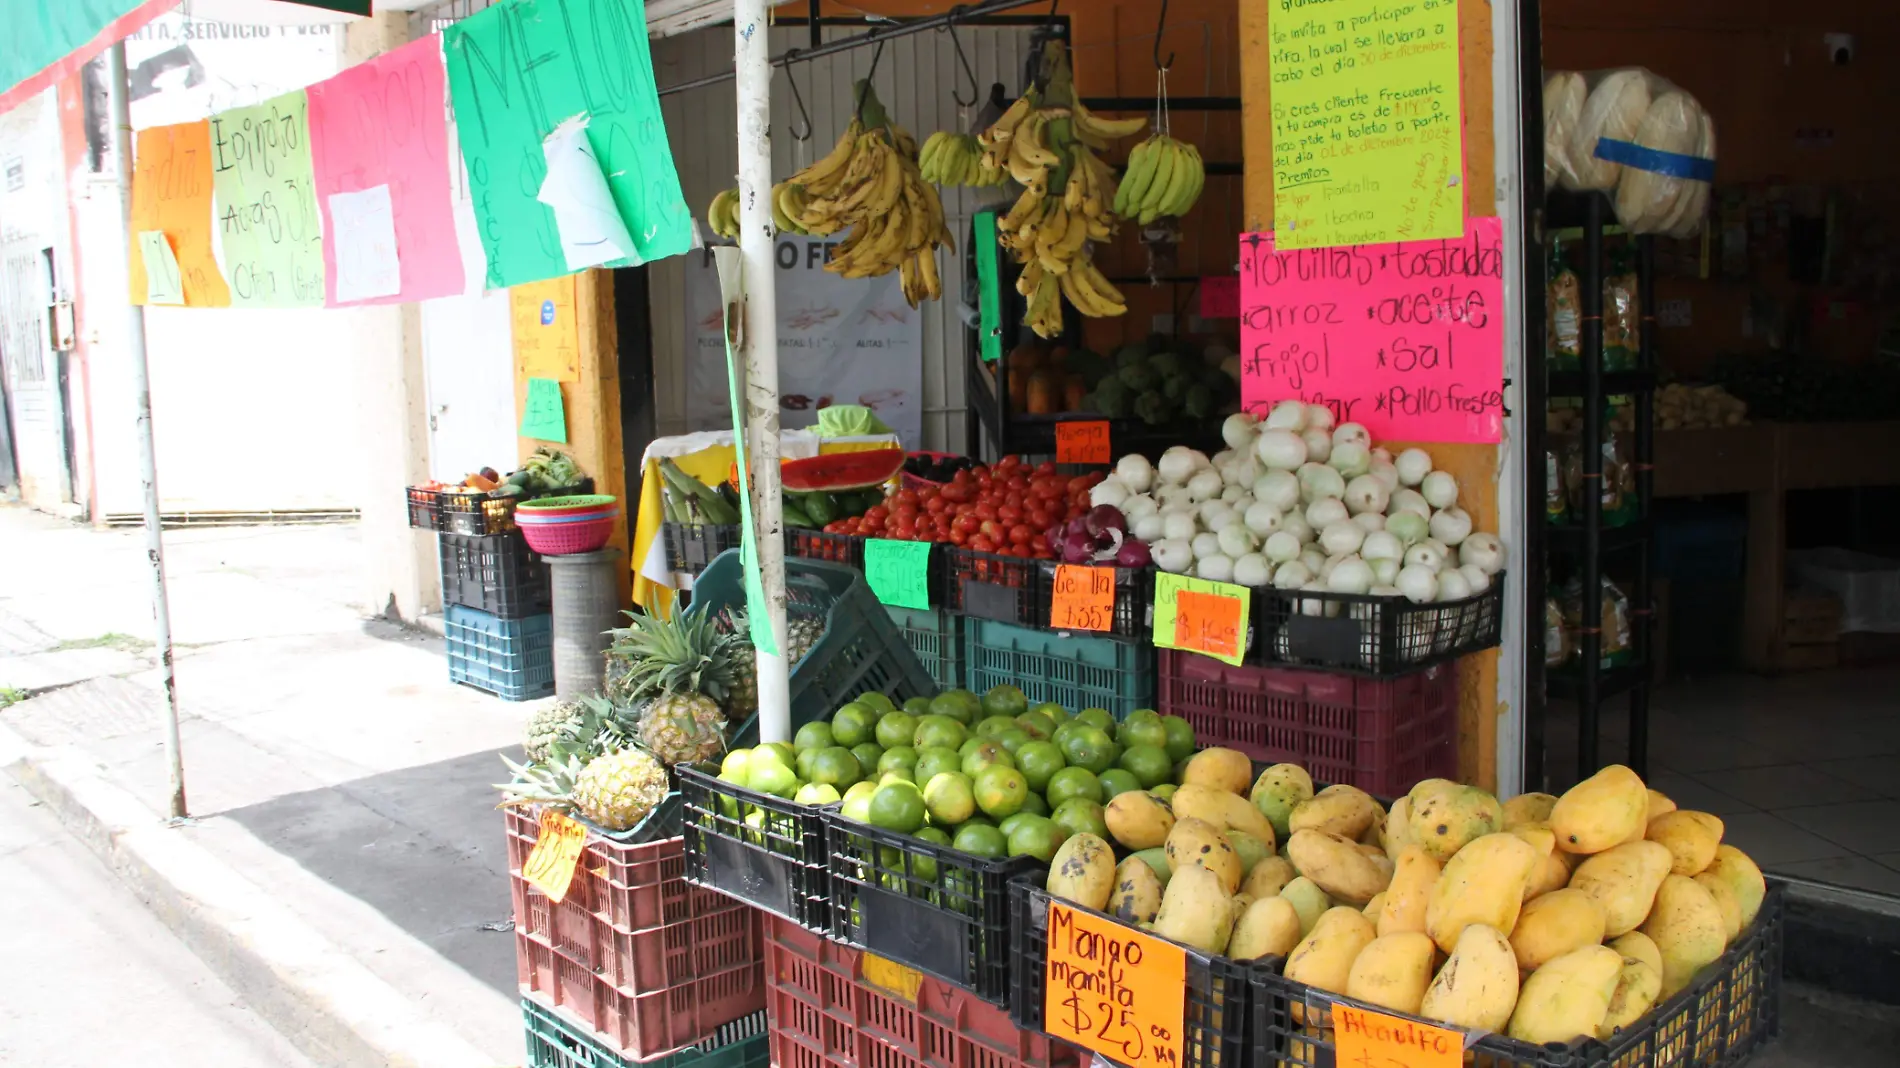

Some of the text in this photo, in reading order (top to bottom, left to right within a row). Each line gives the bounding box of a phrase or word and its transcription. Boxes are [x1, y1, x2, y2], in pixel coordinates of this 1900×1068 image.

[1272, 23, 1287, 44] te
[1291, 20, 1326, 39] invita
[1351, 5, 1417, 31] participar
[1324, 38, 1348, 55] cual
[1274, 66, 1304, 83] cabo
[1310, 63, 1324, 77] el
[1290, 102, 1320, 118] eres
[1303, 115, 1342, 129] compra
[1373, 105, 1391, 118] de
[1276, 167, 1330, 185] Premios
[1250, 283, 1488, 333] arroz aceite
[1056, 565, 1109, 595] Cella
[1053, 906, 1143, 970] Mango
[1051, 959, 1134, 1007] manila
